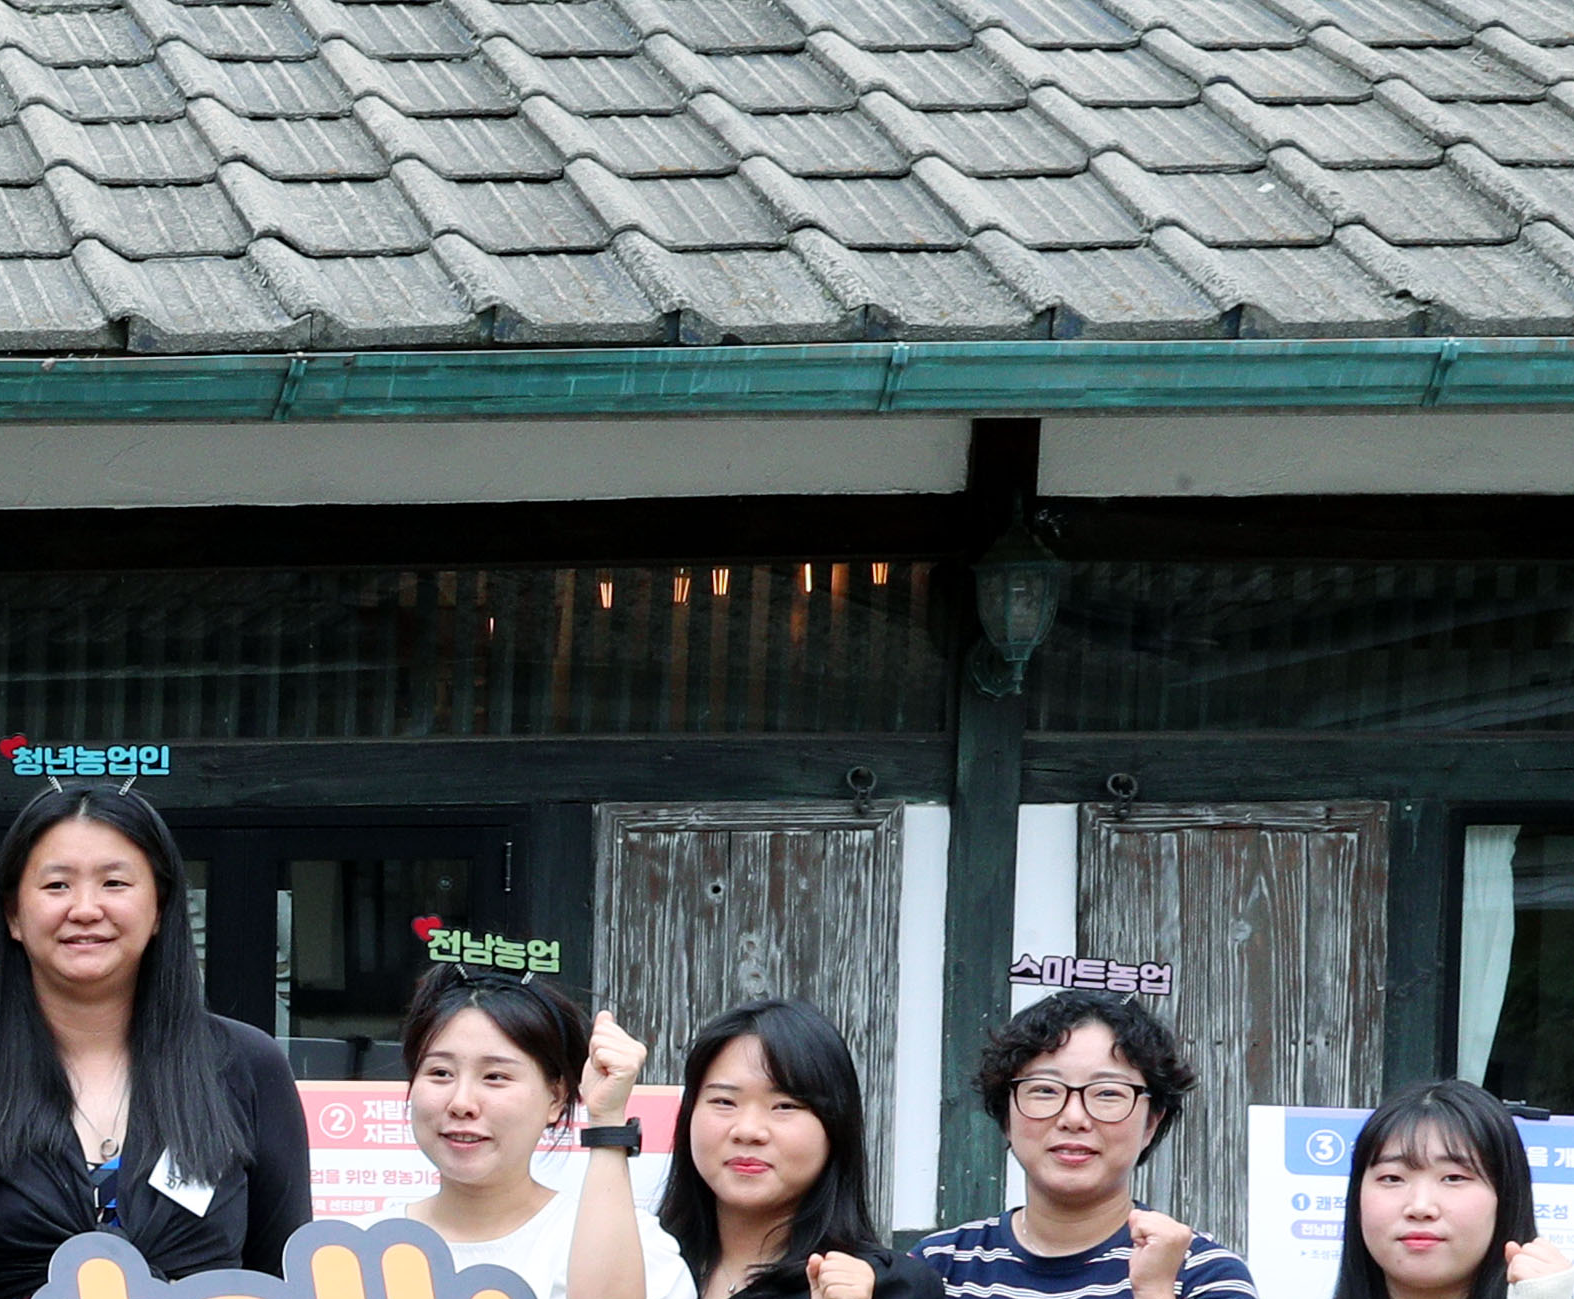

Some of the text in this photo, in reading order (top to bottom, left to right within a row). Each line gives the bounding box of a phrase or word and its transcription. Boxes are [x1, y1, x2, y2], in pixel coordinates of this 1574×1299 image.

[11, 745, 171, 776] 청년농업인
[427, 928, 560, 973] 전남농업
[1008, 954, 1172, 995] 스마트농업
[345, 1169, 377, 1185] 위한
